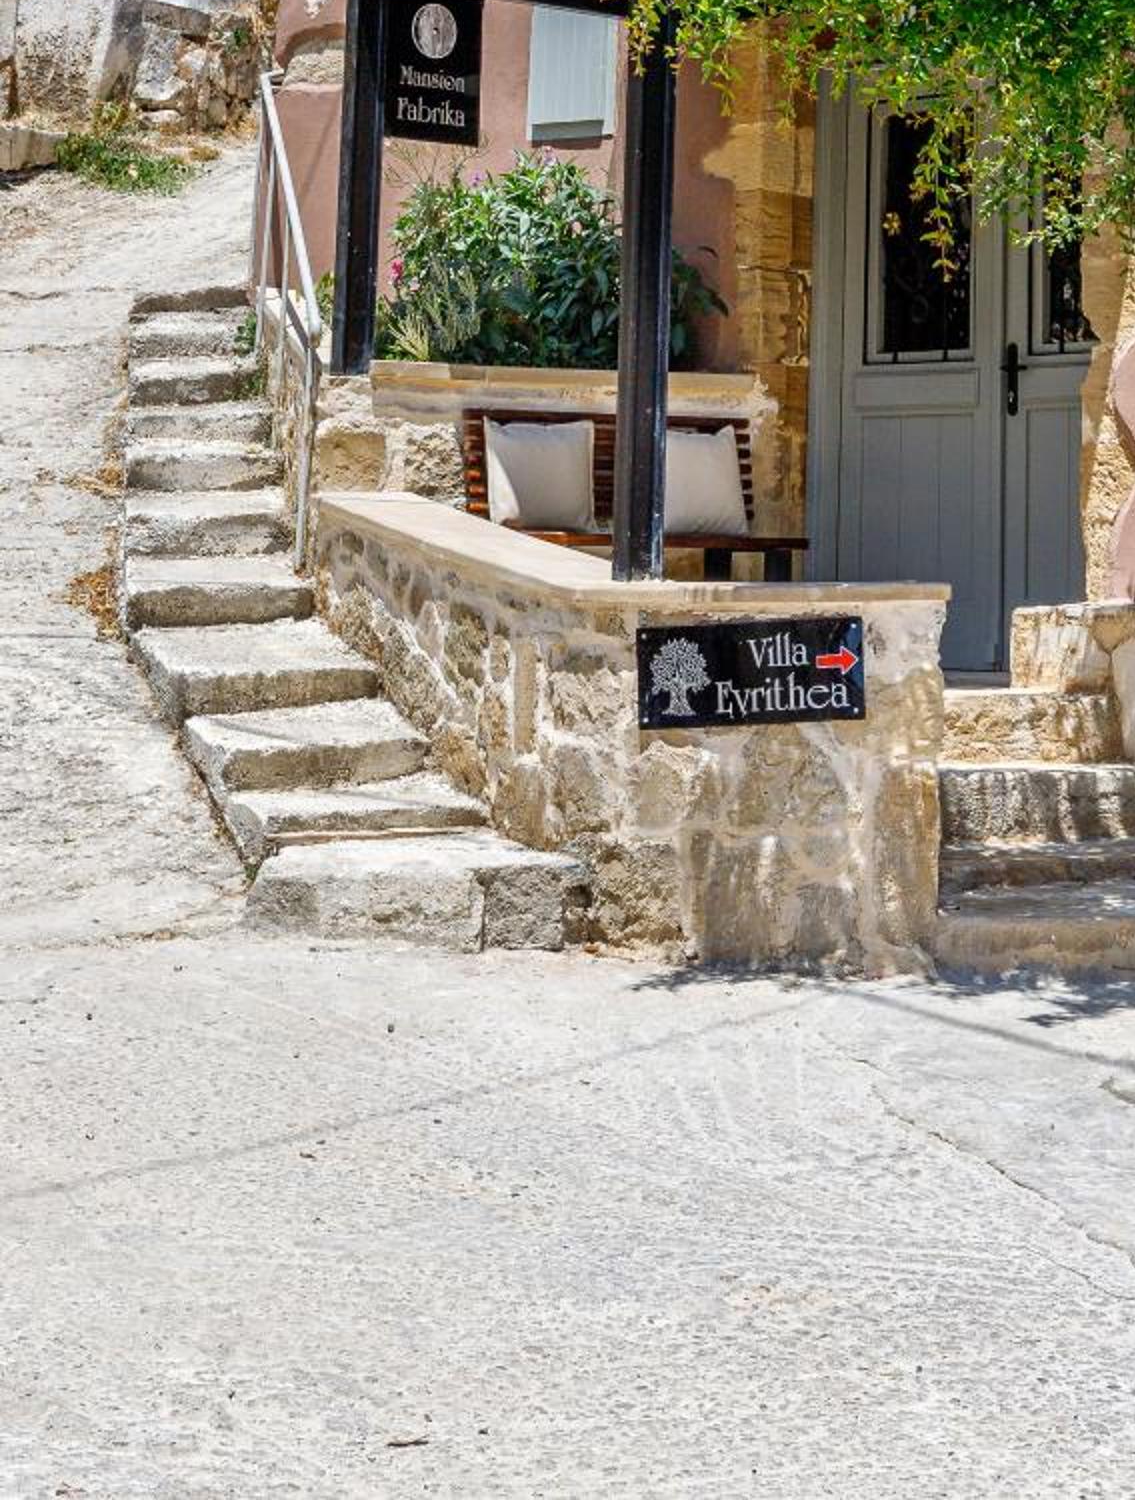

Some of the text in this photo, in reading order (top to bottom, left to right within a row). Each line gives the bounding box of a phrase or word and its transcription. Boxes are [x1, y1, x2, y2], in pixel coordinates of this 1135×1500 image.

[400, 65, 465, 92] Mansion
[396, 96, 465, 127] Fabrika
[747, 632, 810, 668] Villa
